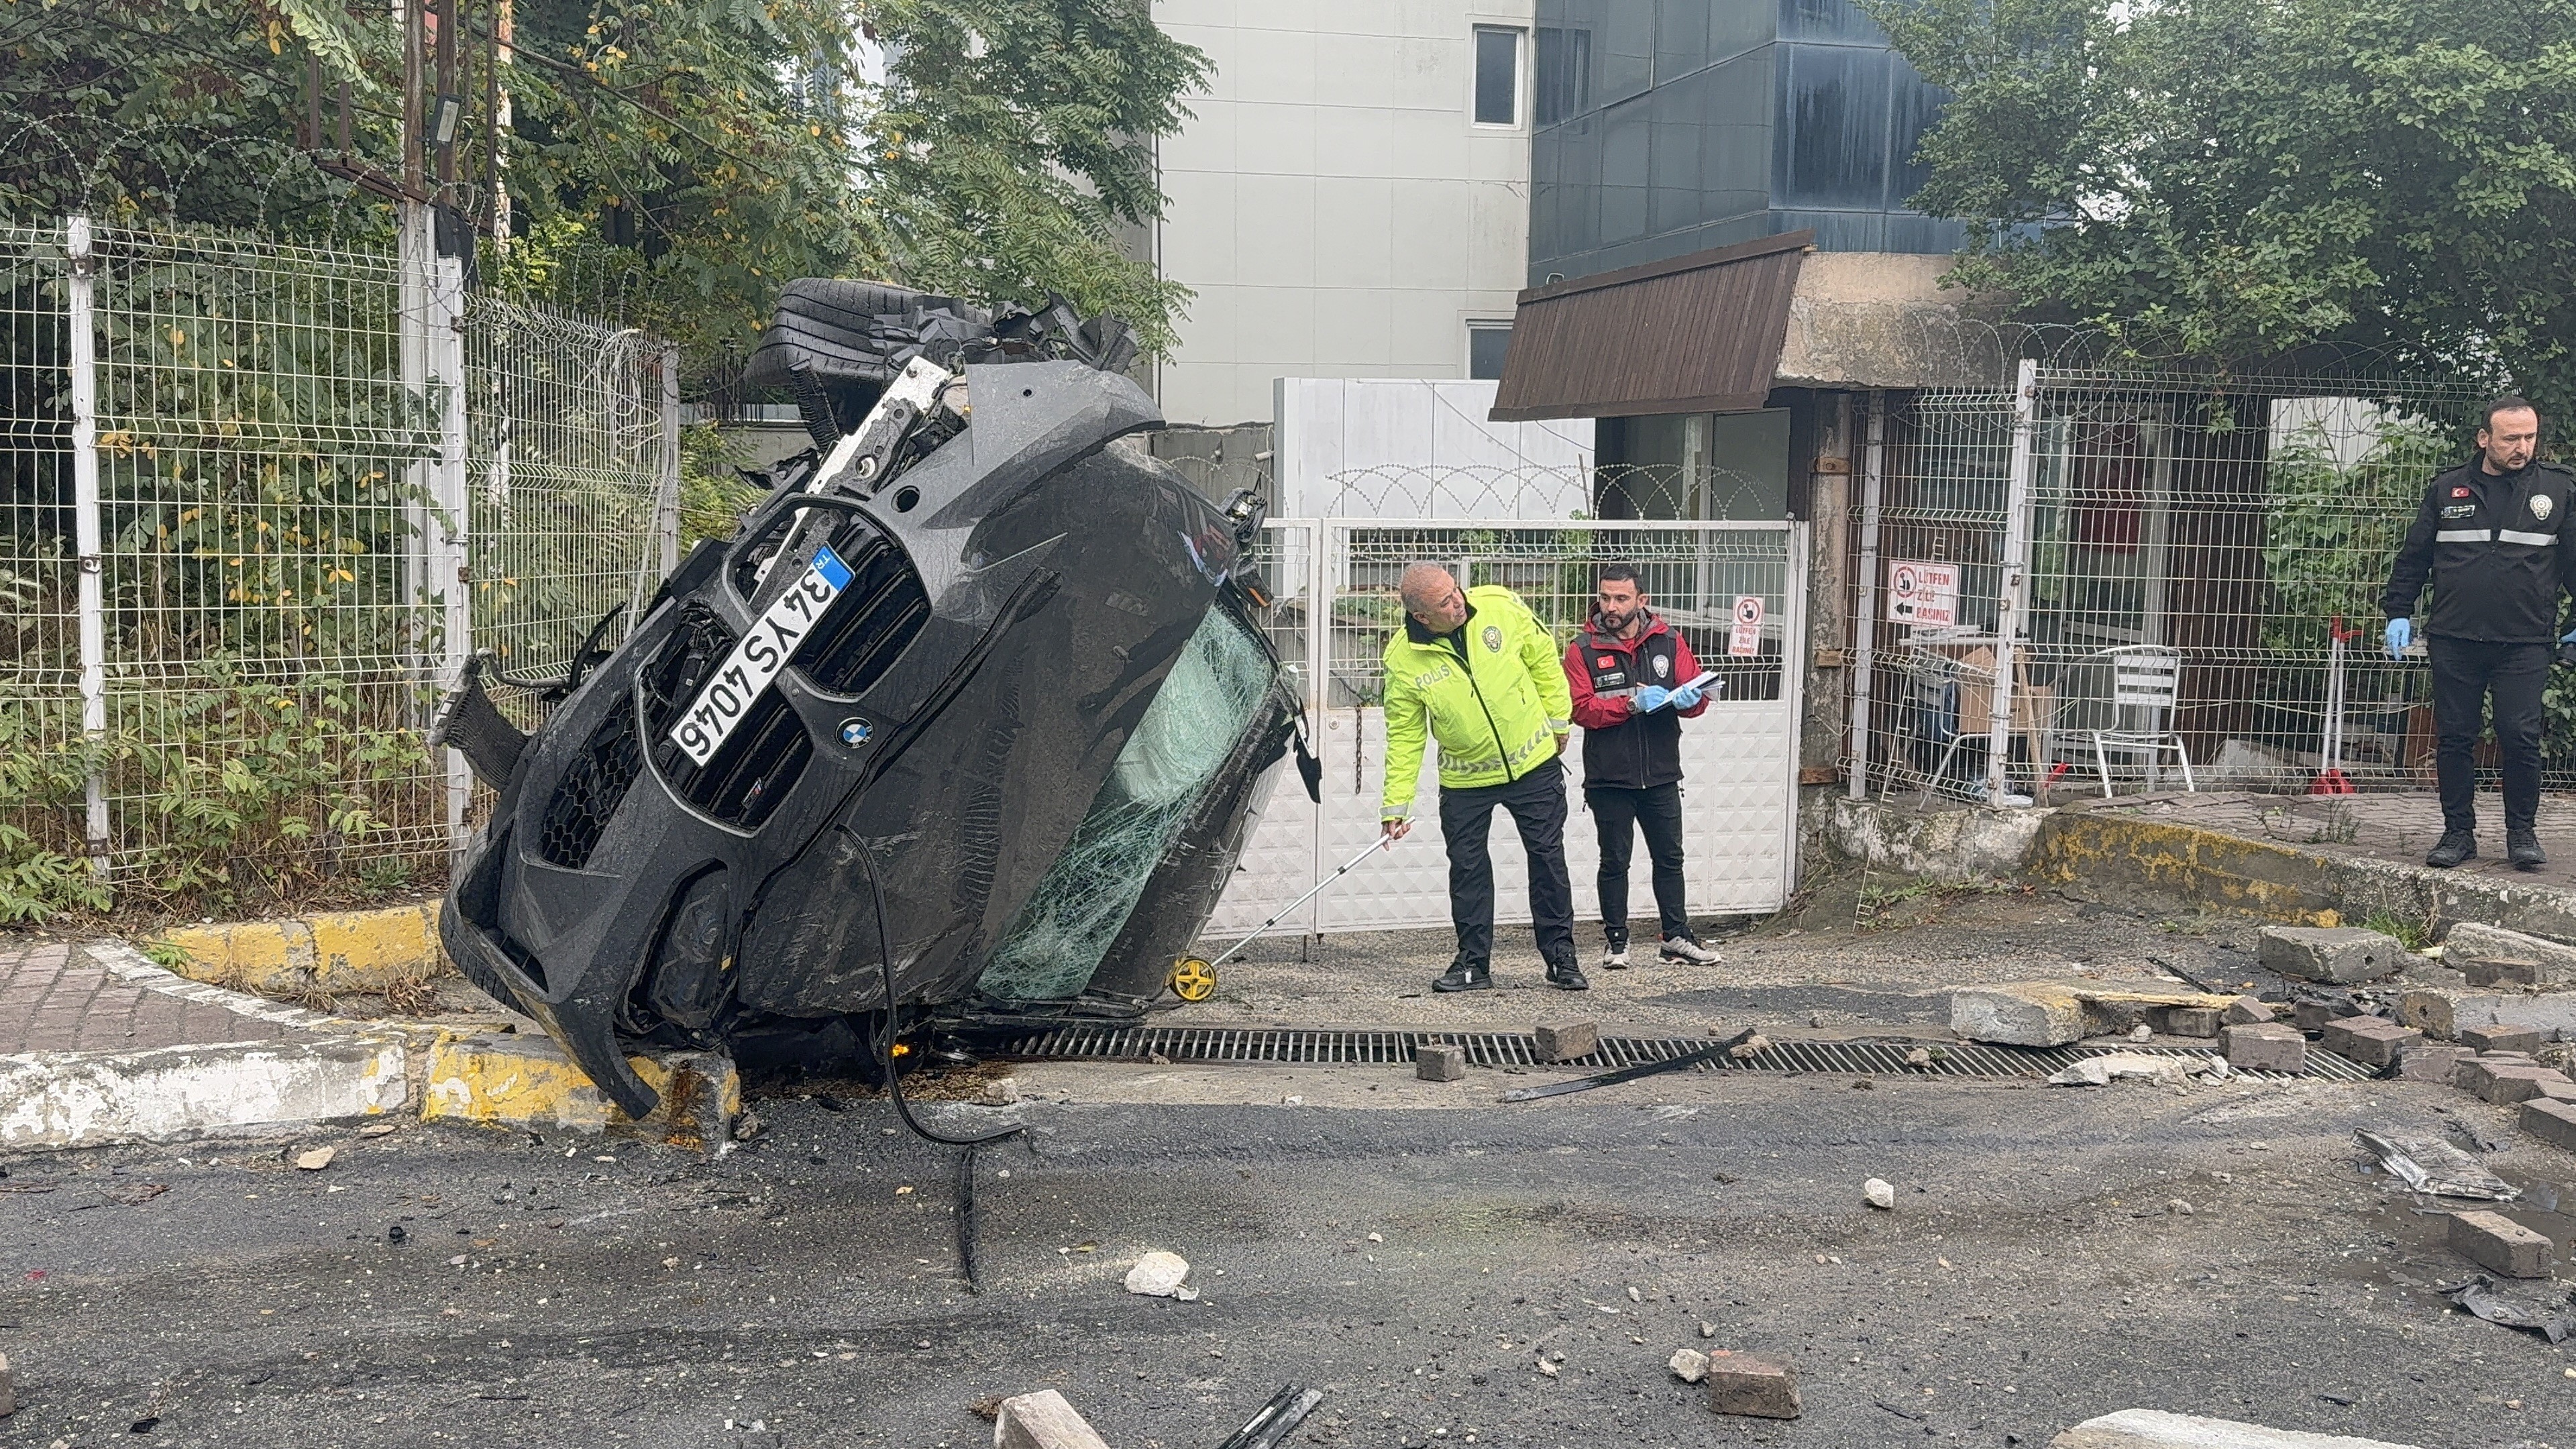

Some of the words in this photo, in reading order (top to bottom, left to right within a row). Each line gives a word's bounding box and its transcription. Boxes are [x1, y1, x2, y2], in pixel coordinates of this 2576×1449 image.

[815, 554, 831, 570] TR
[784, 569, 830, 623] 34
[745, 616, 800, 674] YS
[1415, 664, 1450, 690] POLİS
[679, 664, 753, 757] 4046
